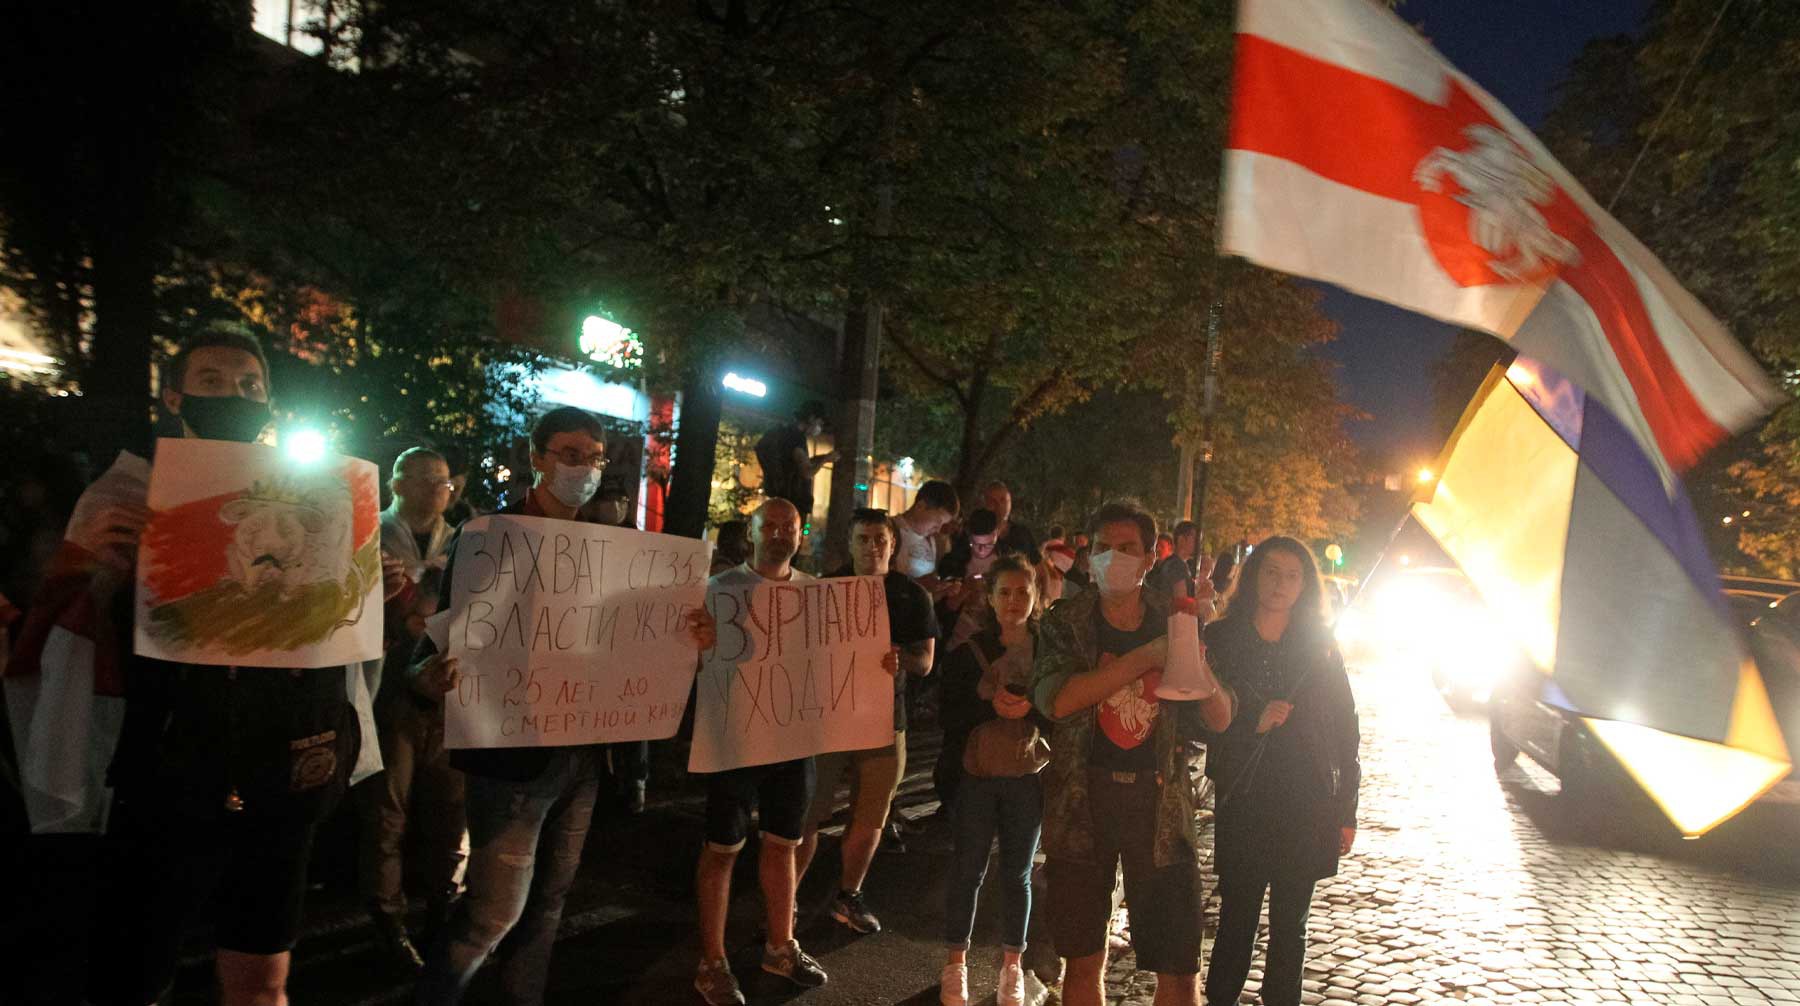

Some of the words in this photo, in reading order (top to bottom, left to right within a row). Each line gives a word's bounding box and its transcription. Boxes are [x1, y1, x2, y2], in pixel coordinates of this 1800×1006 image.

[471, 532, 611, 596] ЗАХВАТ
[464, 601, 619, 652] ВЛАСТИ
[457, 674, 488, 706] ОТ
[503, 666, 551, 706] 25
[556, 679, 603, 705] ЛЕТ
[619, 677, 648, 701] ДО
[712, 651, 855, 735] УХОДИ
[501, 704, 637, 737] СМЕРТНОЙ
